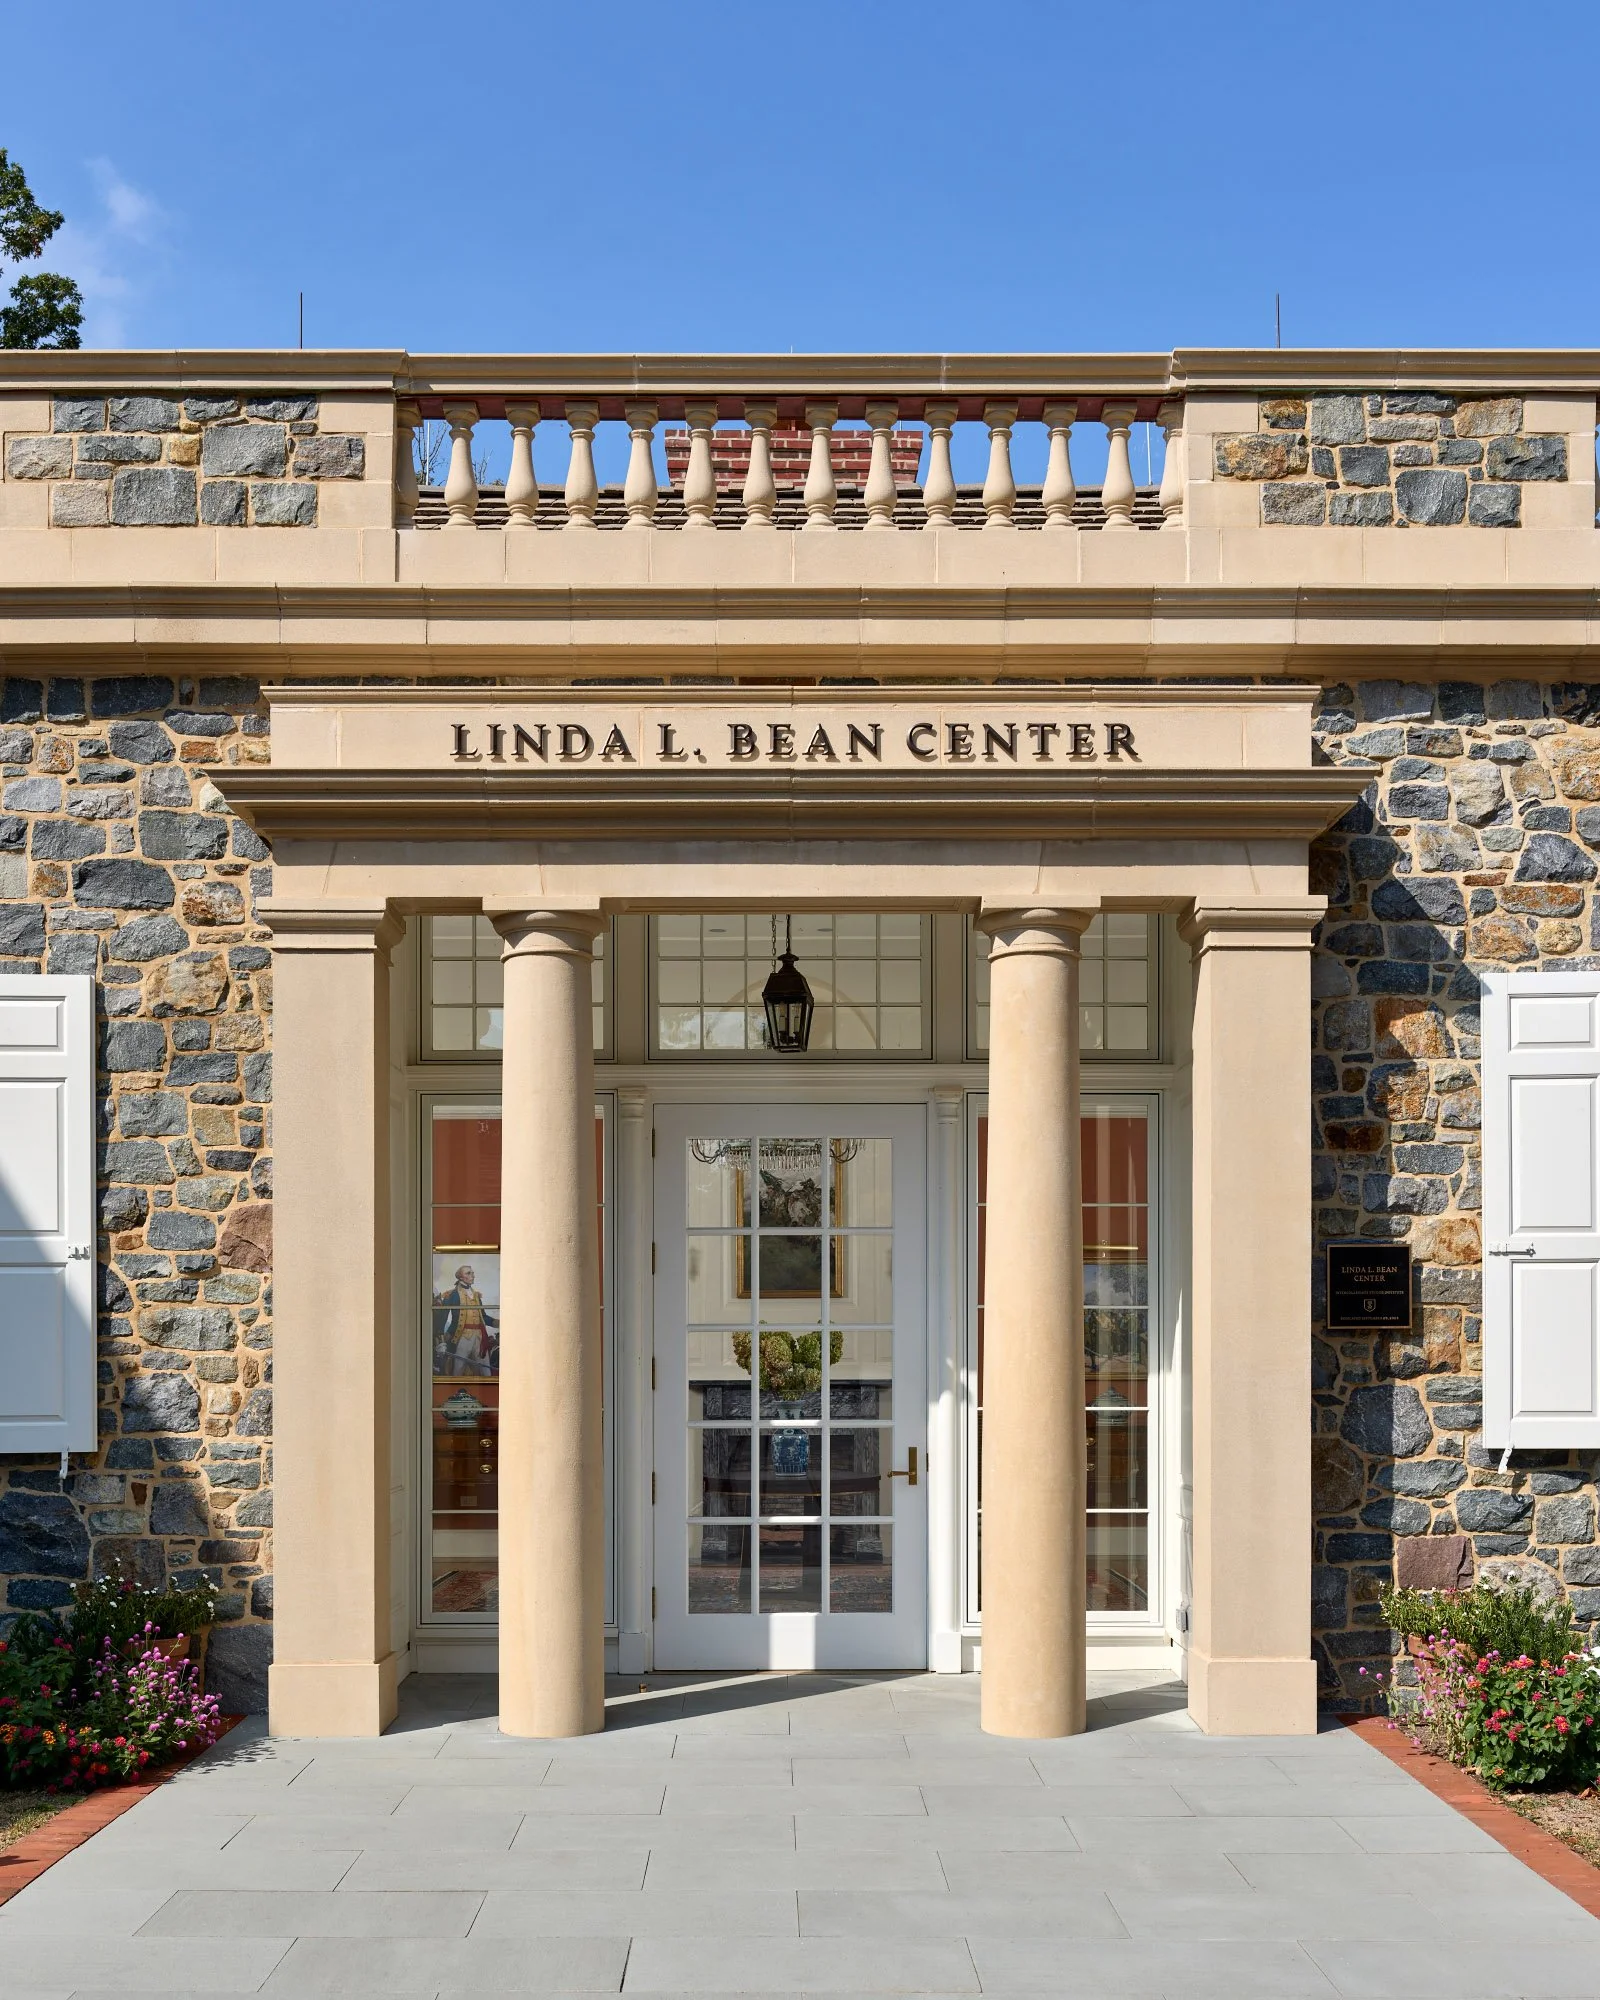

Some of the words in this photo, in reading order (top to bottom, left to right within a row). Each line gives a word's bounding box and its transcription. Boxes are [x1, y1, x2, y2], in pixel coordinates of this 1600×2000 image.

[450, 723, 634, 758] LINDA
[656, 723, 702, 758] L.
[726, 723, 881, 758] BEAN
[906, 722, 1139, 758] CENTER
[1353, 1274, 1386, 1282] CENTER
